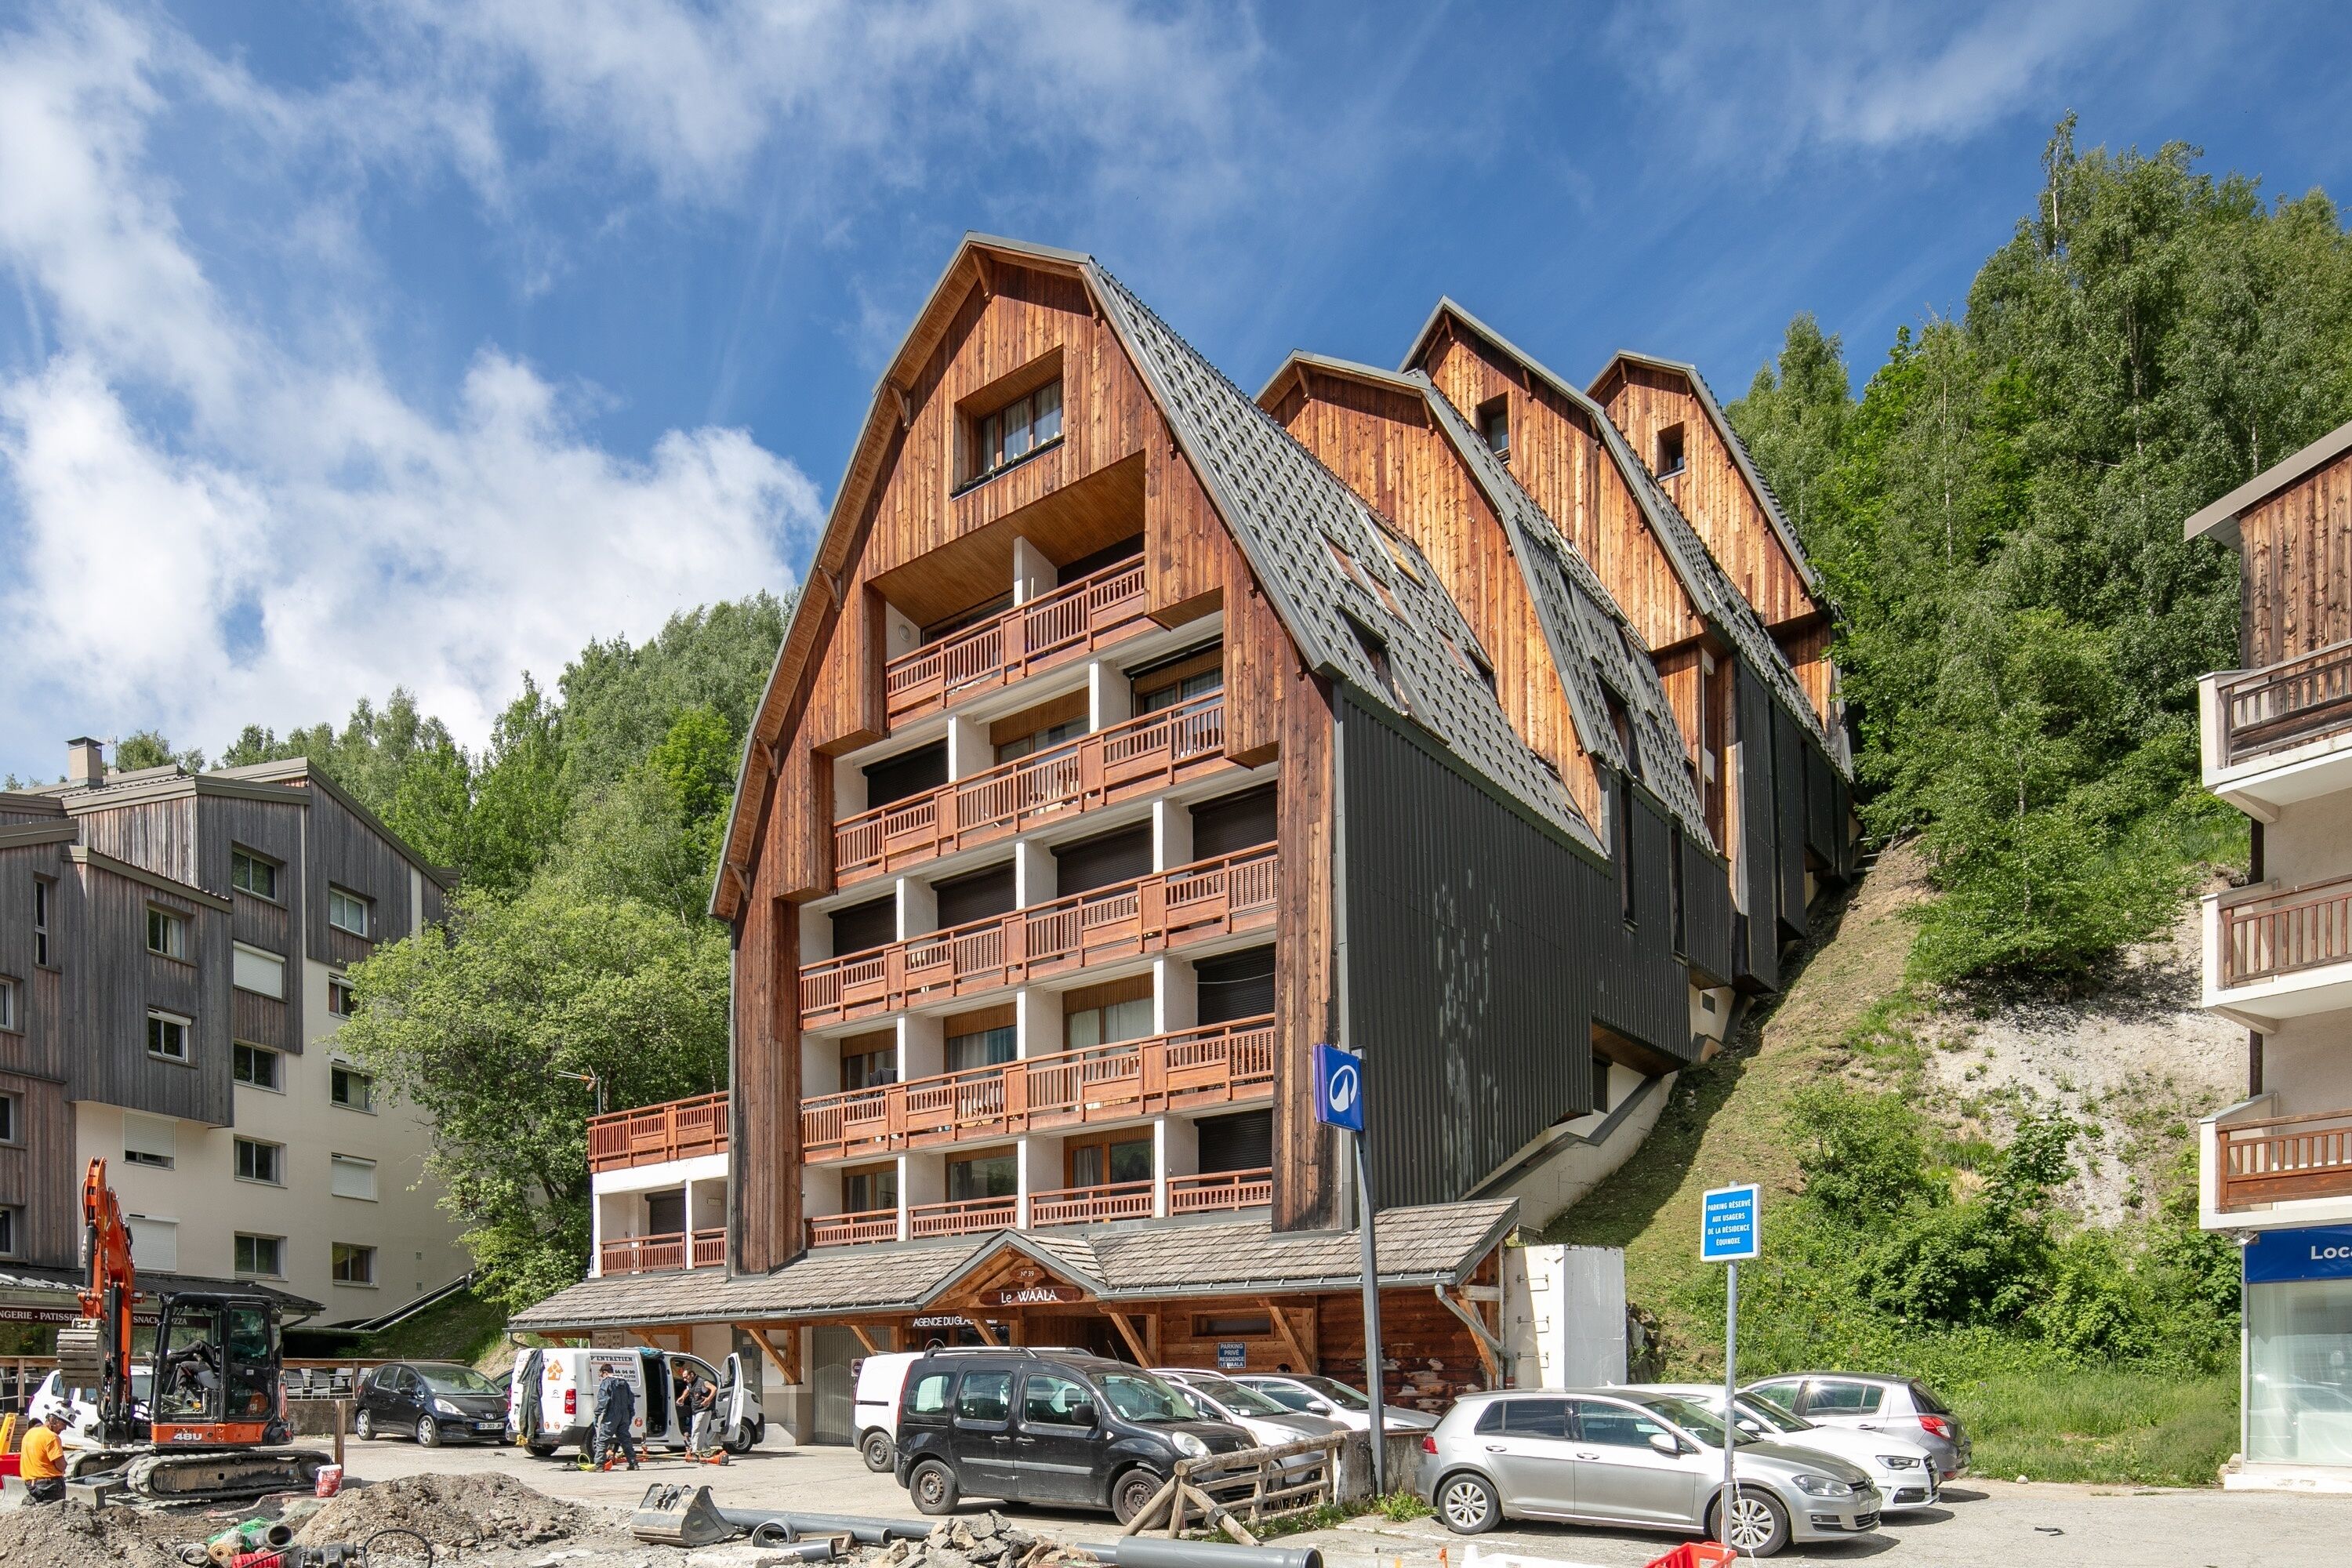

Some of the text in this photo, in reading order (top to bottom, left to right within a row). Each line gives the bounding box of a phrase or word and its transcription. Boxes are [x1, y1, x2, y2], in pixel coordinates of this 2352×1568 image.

[1708, 1199, 1751, 1211] PARKING RÉSERVÉ
[1722, 1213, 1745, 1221] USAGERS
[1722, 1224, 1750, 1233] RÉSIDENCE
[1716, 1237, 1740, 1246] ÉQUINOXE
[2311, 1246, 2352, 1259] Loc
[1001, 1293, 1012, 1303] Le
[40, 1312, 82, 1321] PATISSER
[913, 1317, 942, 1327] AGENCE
[943, 1316, 953, 1325] DU
